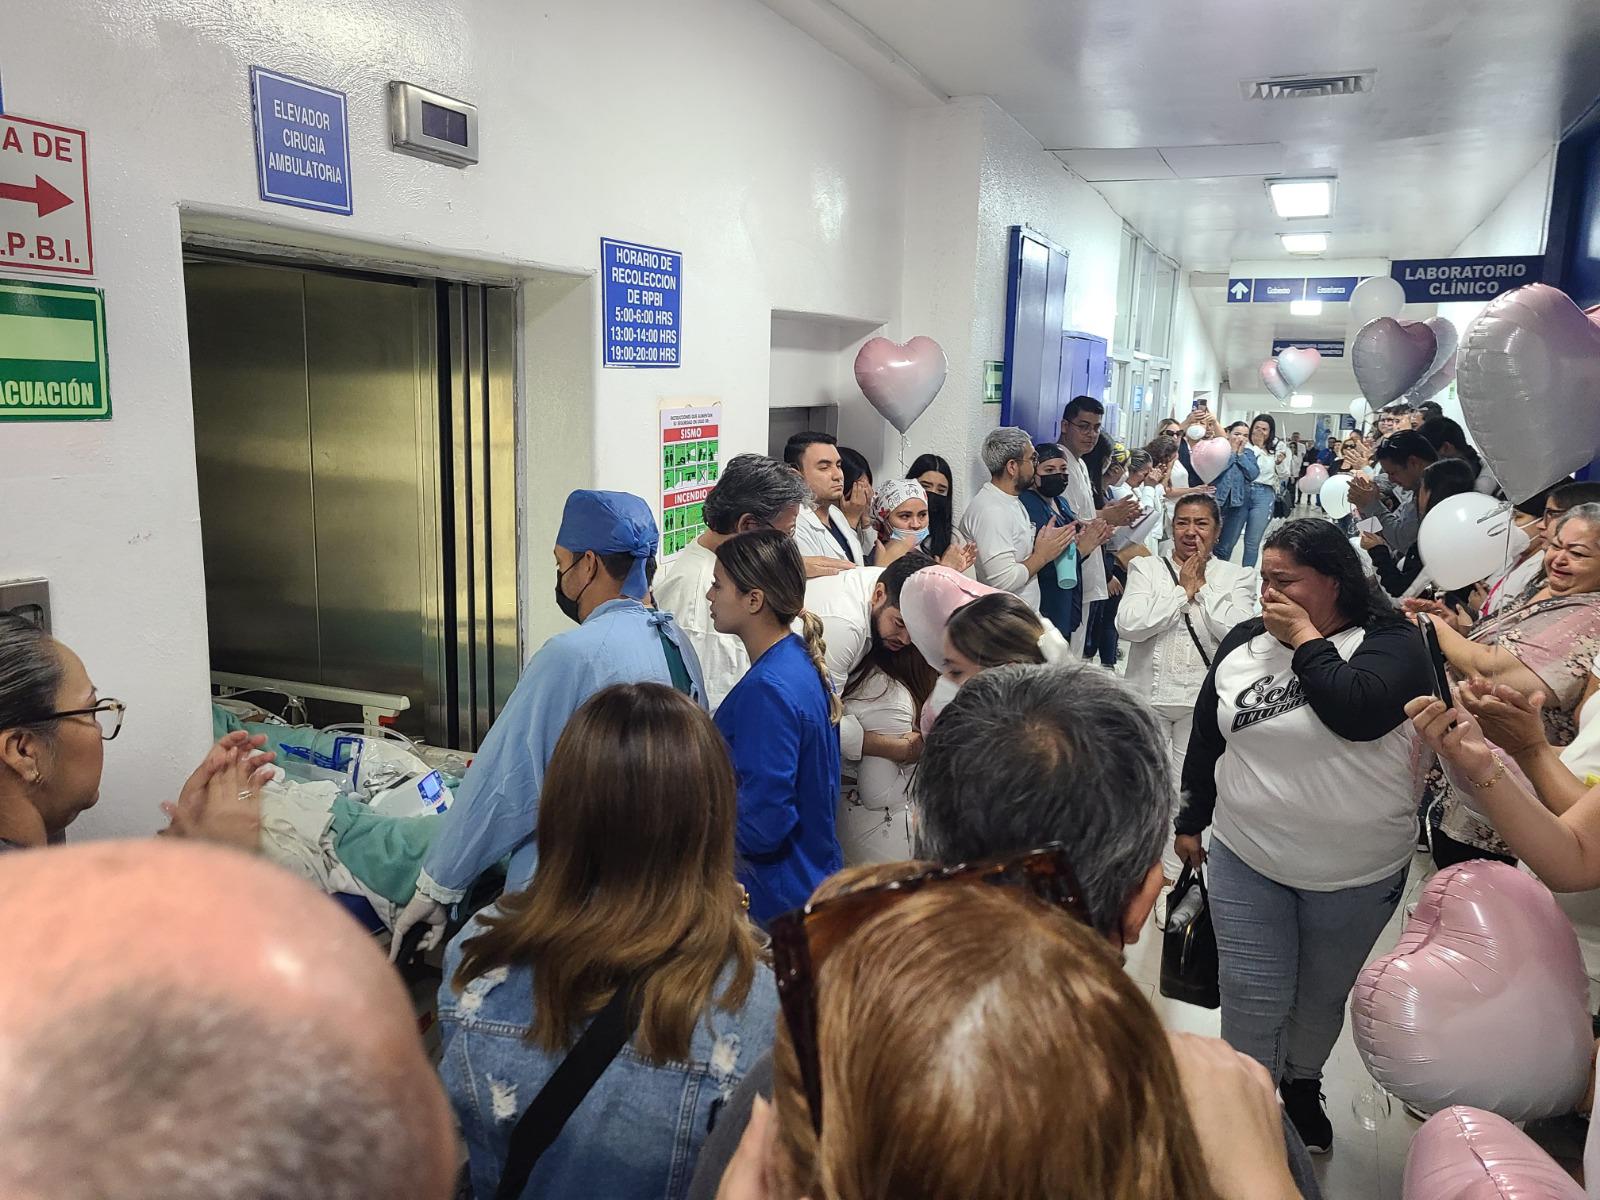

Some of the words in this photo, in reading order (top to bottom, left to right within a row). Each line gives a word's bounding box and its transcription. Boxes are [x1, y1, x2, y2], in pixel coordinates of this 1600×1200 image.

[274, 99, 330, 131] ELEVADOR
[33, 131, 73, 163] DE
[283, 128, 326, 156] CIRUGIA
[268, 151, 343, 185] AMBULATORIA
[616, 247, 659, 269] HORARIO
[660, 256, 673, 272] DE
[611, 266, 677, 290] RECOLECCION
[1404, 263, 1527, 281] LABORATORIO
[1428, 278, 1500, 296] CLÍNICO
[627, 288, 640, 305] DE
[642, 290, 663, 307] RPBI
[615, 306, 654, 325] 5:00-6:00
[655, 310, 673, 326] HRS
[610, 325, 658, 343] 13:00-14:00
[659, 329, 677, 344] HRS
[610, 345, 658, 361] 19:00-20:00
[659, 347, 677, 362] HRS
[680, 428, 702, 439] SISMO
[674, 489, 708, 505] INCENDIO
[1234, 674, 1305, 710] Eck
